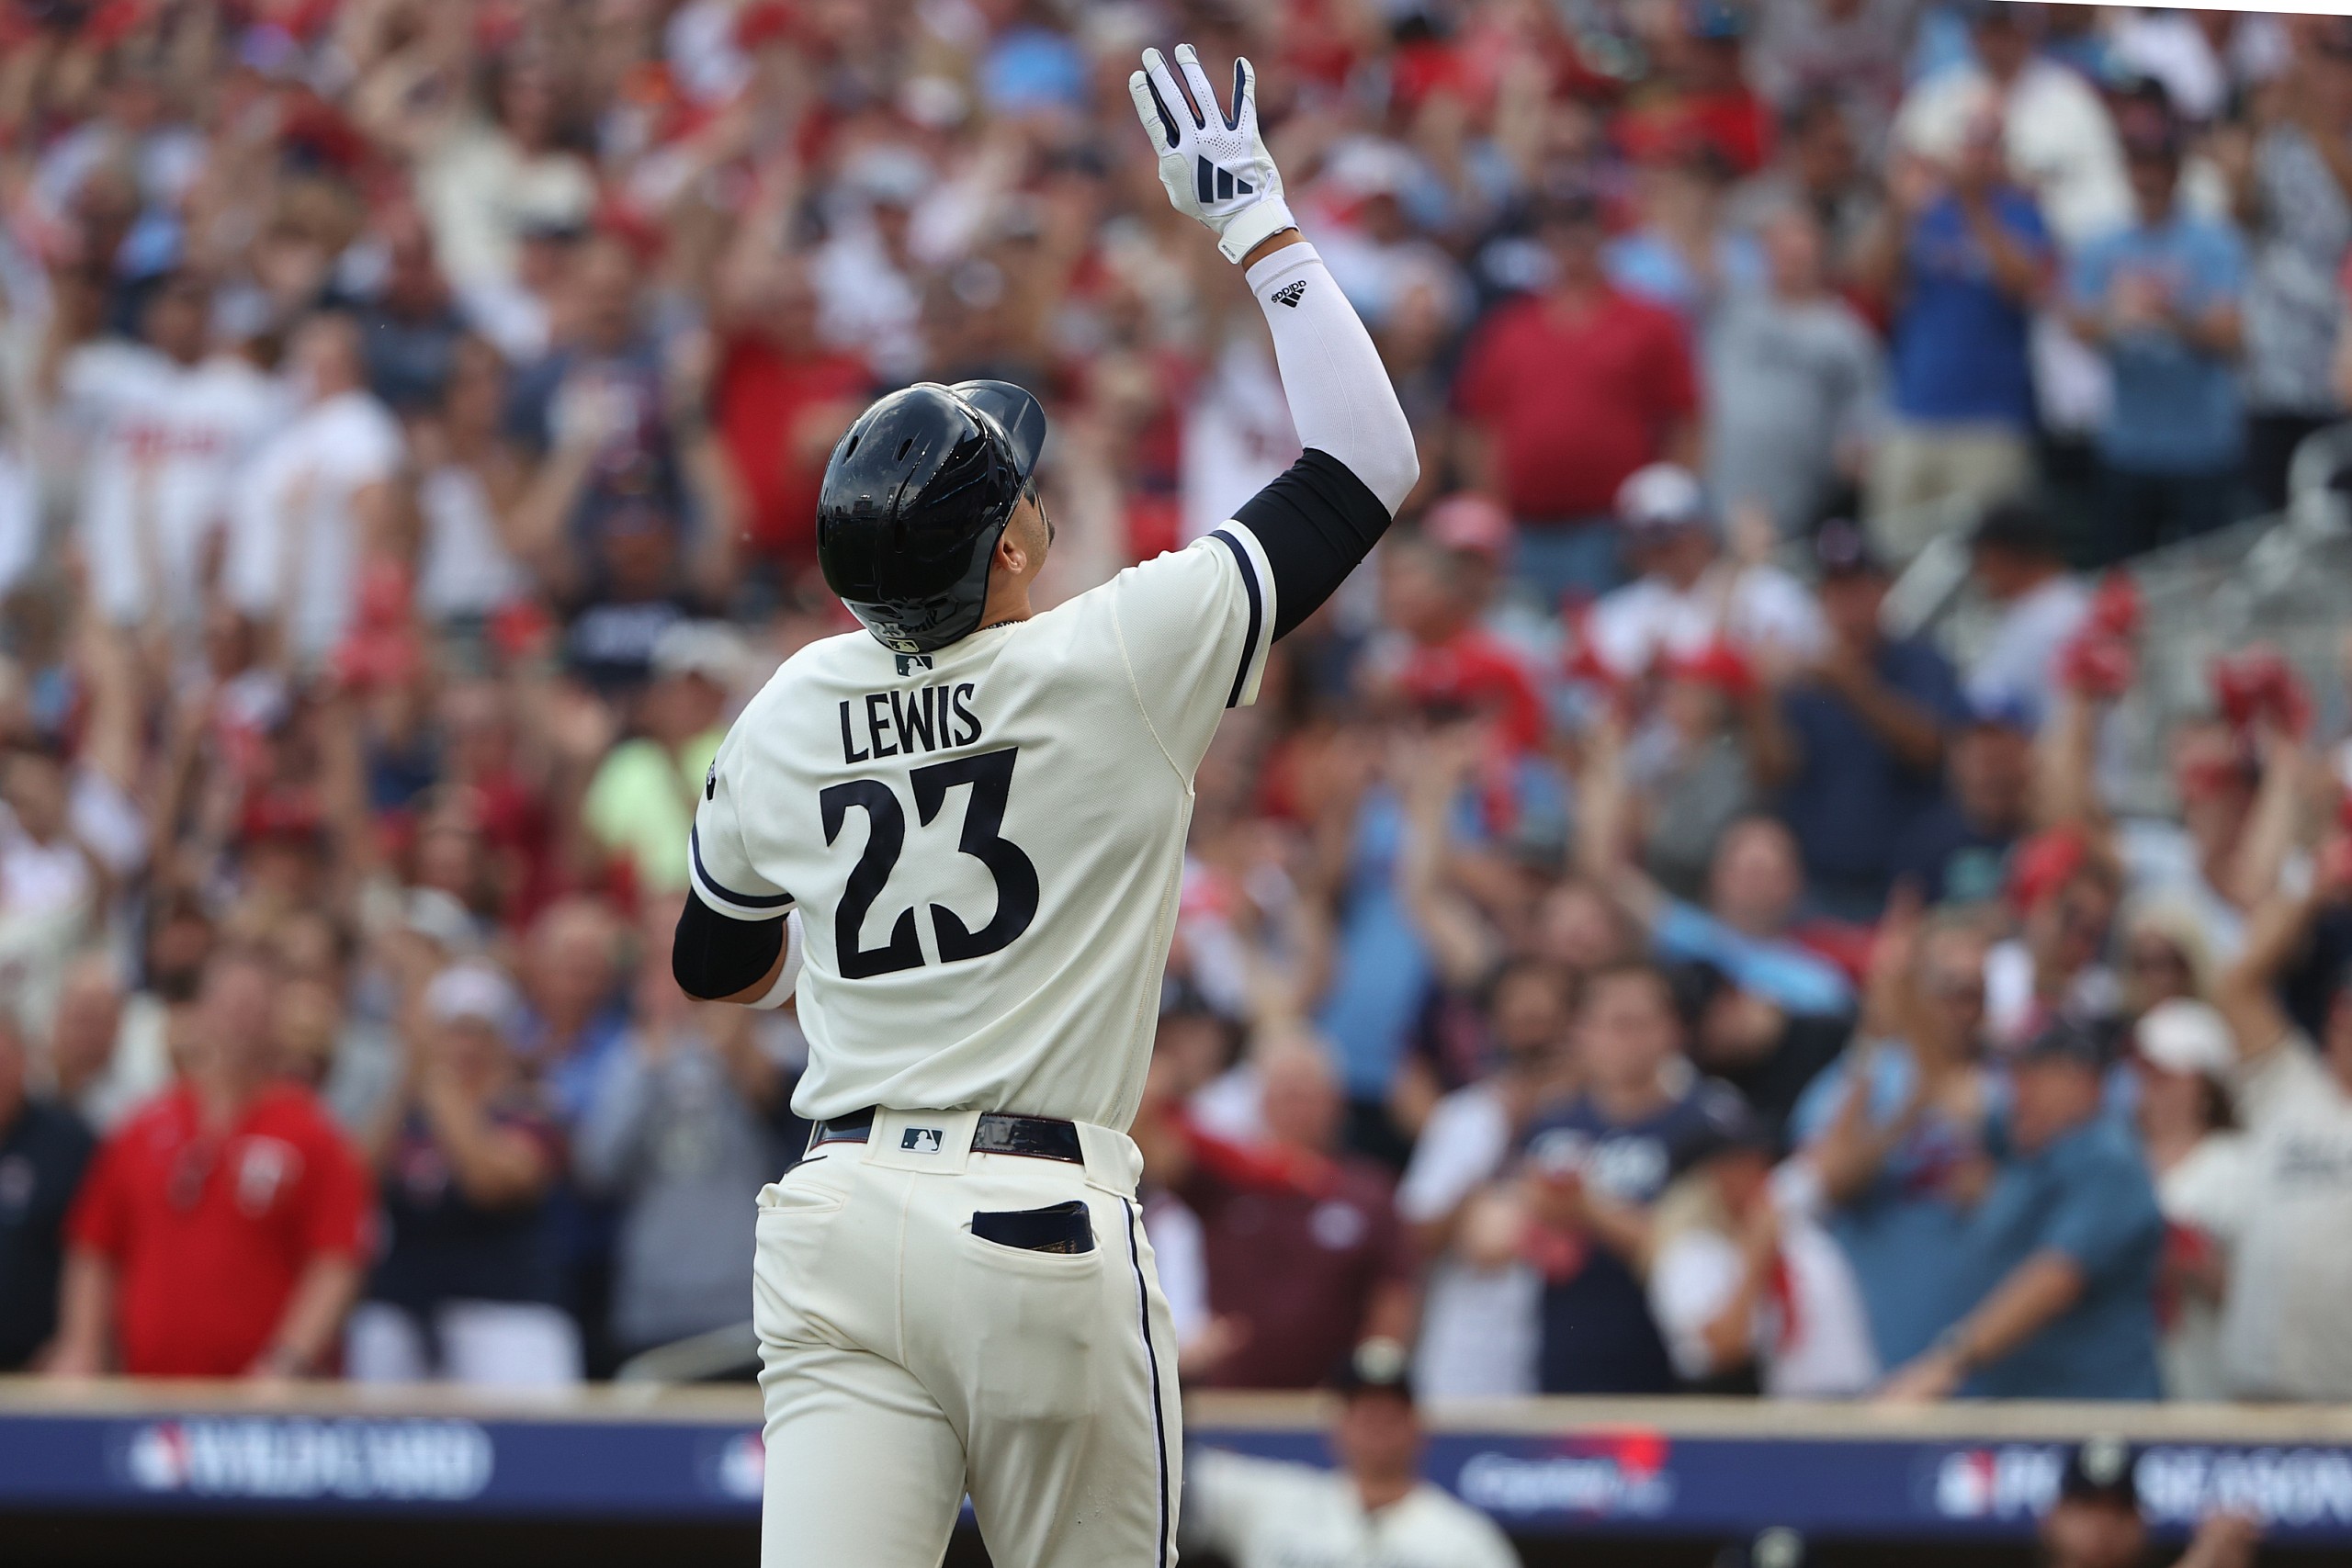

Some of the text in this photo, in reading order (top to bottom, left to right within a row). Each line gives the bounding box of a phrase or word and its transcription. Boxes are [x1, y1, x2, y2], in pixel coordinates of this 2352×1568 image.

[1271, 279, 1306, 304] adidas
[839, 682, 982, 764] LEWIS
[820, 746, 1040, 980] 23
